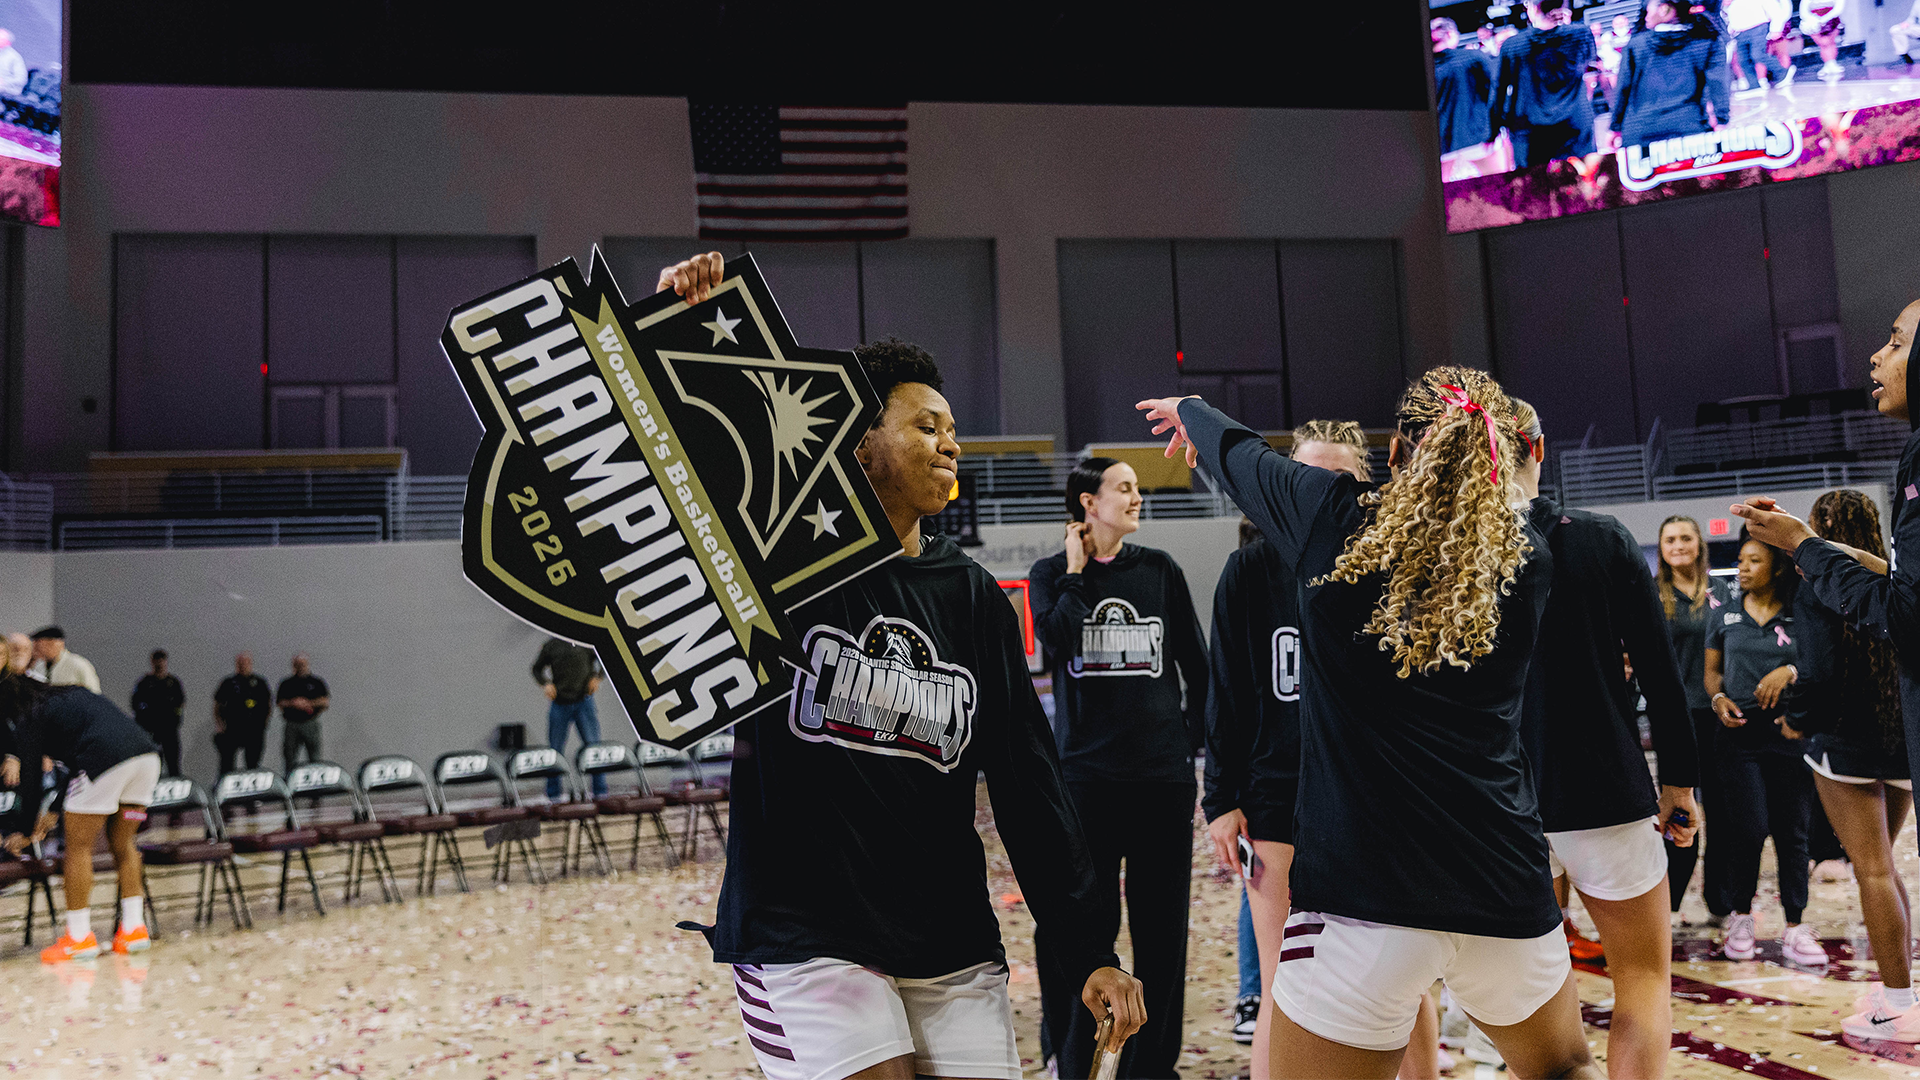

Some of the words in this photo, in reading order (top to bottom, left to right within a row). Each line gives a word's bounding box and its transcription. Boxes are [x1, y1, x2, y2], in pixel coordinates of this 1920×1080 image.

[450, 278, 758, 741] CHAMPIONS
[596, 323, 672, 462] Women's
[666, 461, 761, 624] Basketball
[507, 485, 577, 587] 2026
[860, 653, 890, 669] ATLANTIC
[929, 671, 954, 685] SEASON
[1074, 623, 1160, 671] HAMPIONS
[800, 637, 970, 761] CHAMPIONS
[873, 730, 898, 742] EKU
